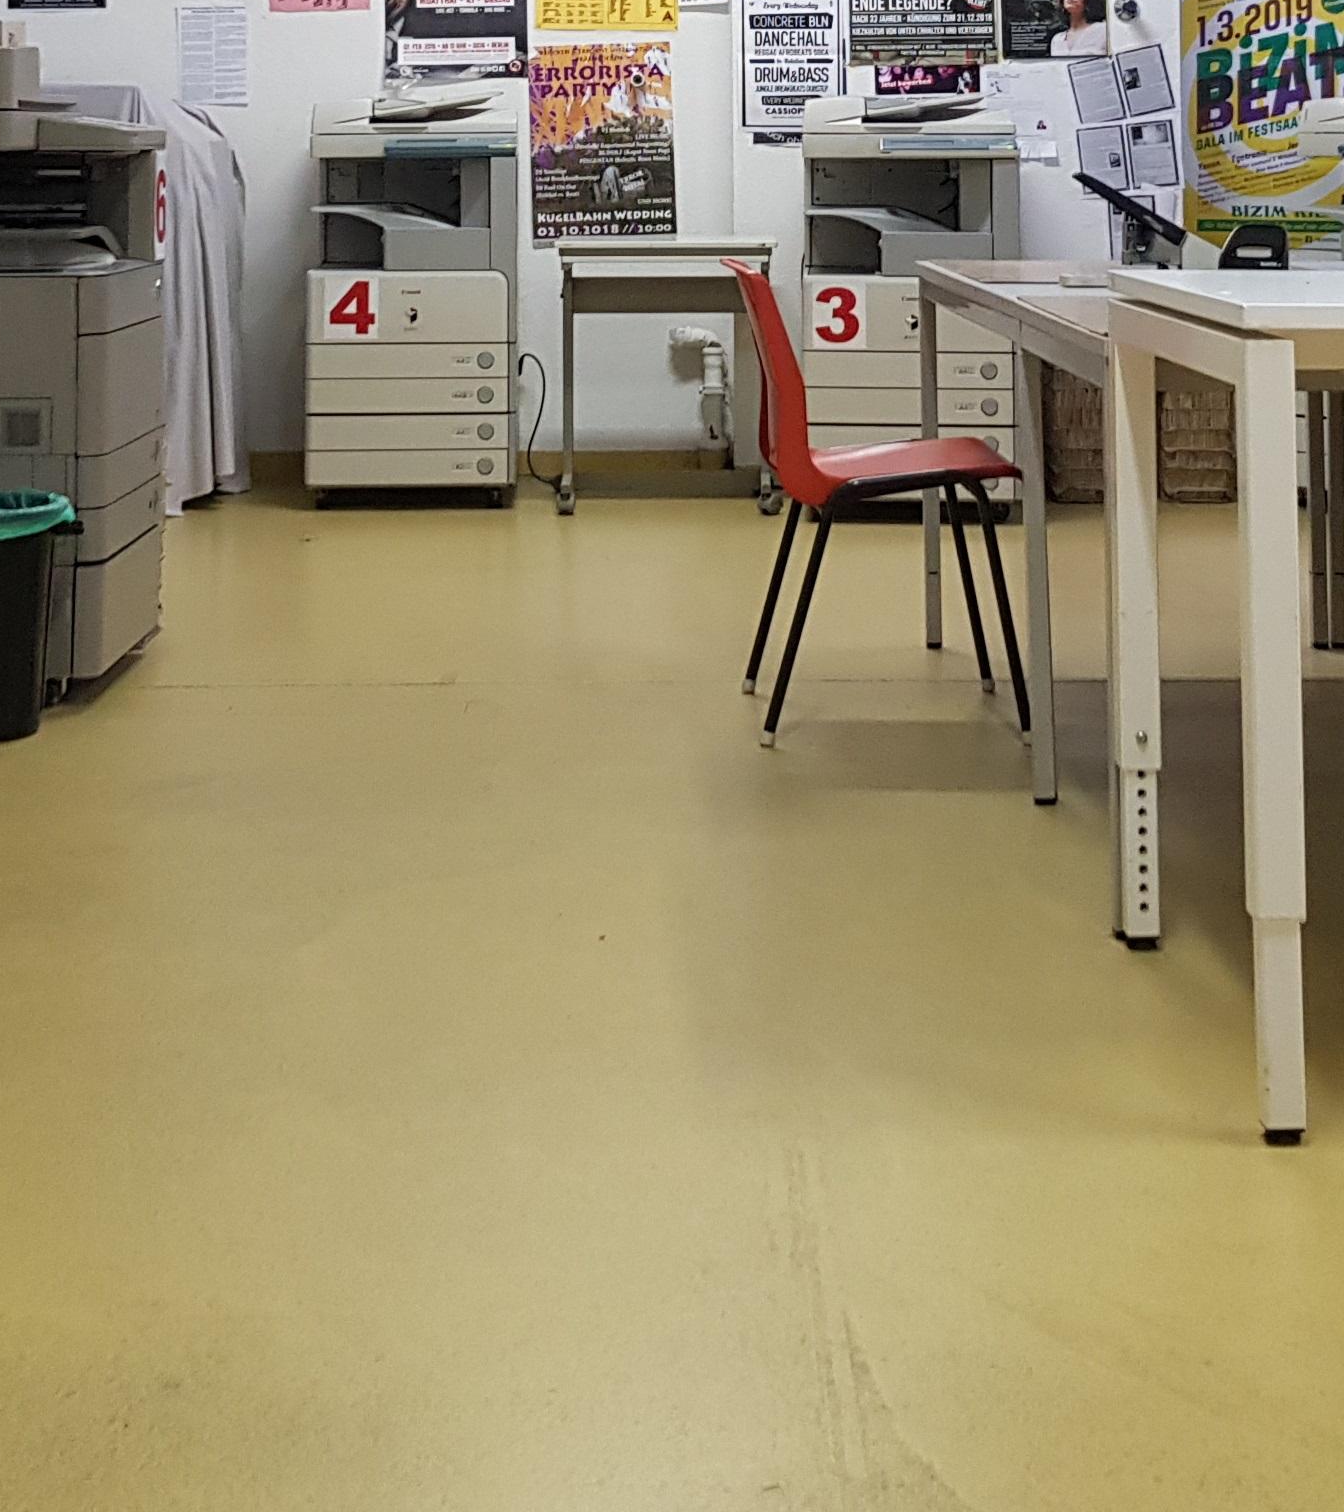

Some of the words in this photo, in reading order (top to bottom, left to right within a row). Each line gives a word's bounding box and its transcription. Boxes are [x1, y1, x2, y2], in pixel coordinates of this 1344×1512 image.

[783, 1, 819, 10] Wednesday
[753, 15, 806, 28] CONCRETE
[808, 15, 829, 27] BLN
[852, 15, 869, 24] NACH
[754, 31, 829, 47] DANCEHALL
[754, 67, 829, 83] DRUM&BASS
[763, 96, 781, 105] EVERY
[765, 107, 805, 115] CASSIOP
[1196, 134, 1225, 151] GALA
[1229, 130, 1244, 144] IM
[1248, 116, 1301, 139] FESTSAA
[157, 169, 167, 244] 6
[537, 210, 612, 224] KUGELBAHN
[613, 209, 673, 221] WEDDING
[537, 224, 620, 237] 02.10.2018
[637, 223, 673, 233] 20:00
[329, 280, 376, 335] 4
[815, 286, 860, 343] 3
